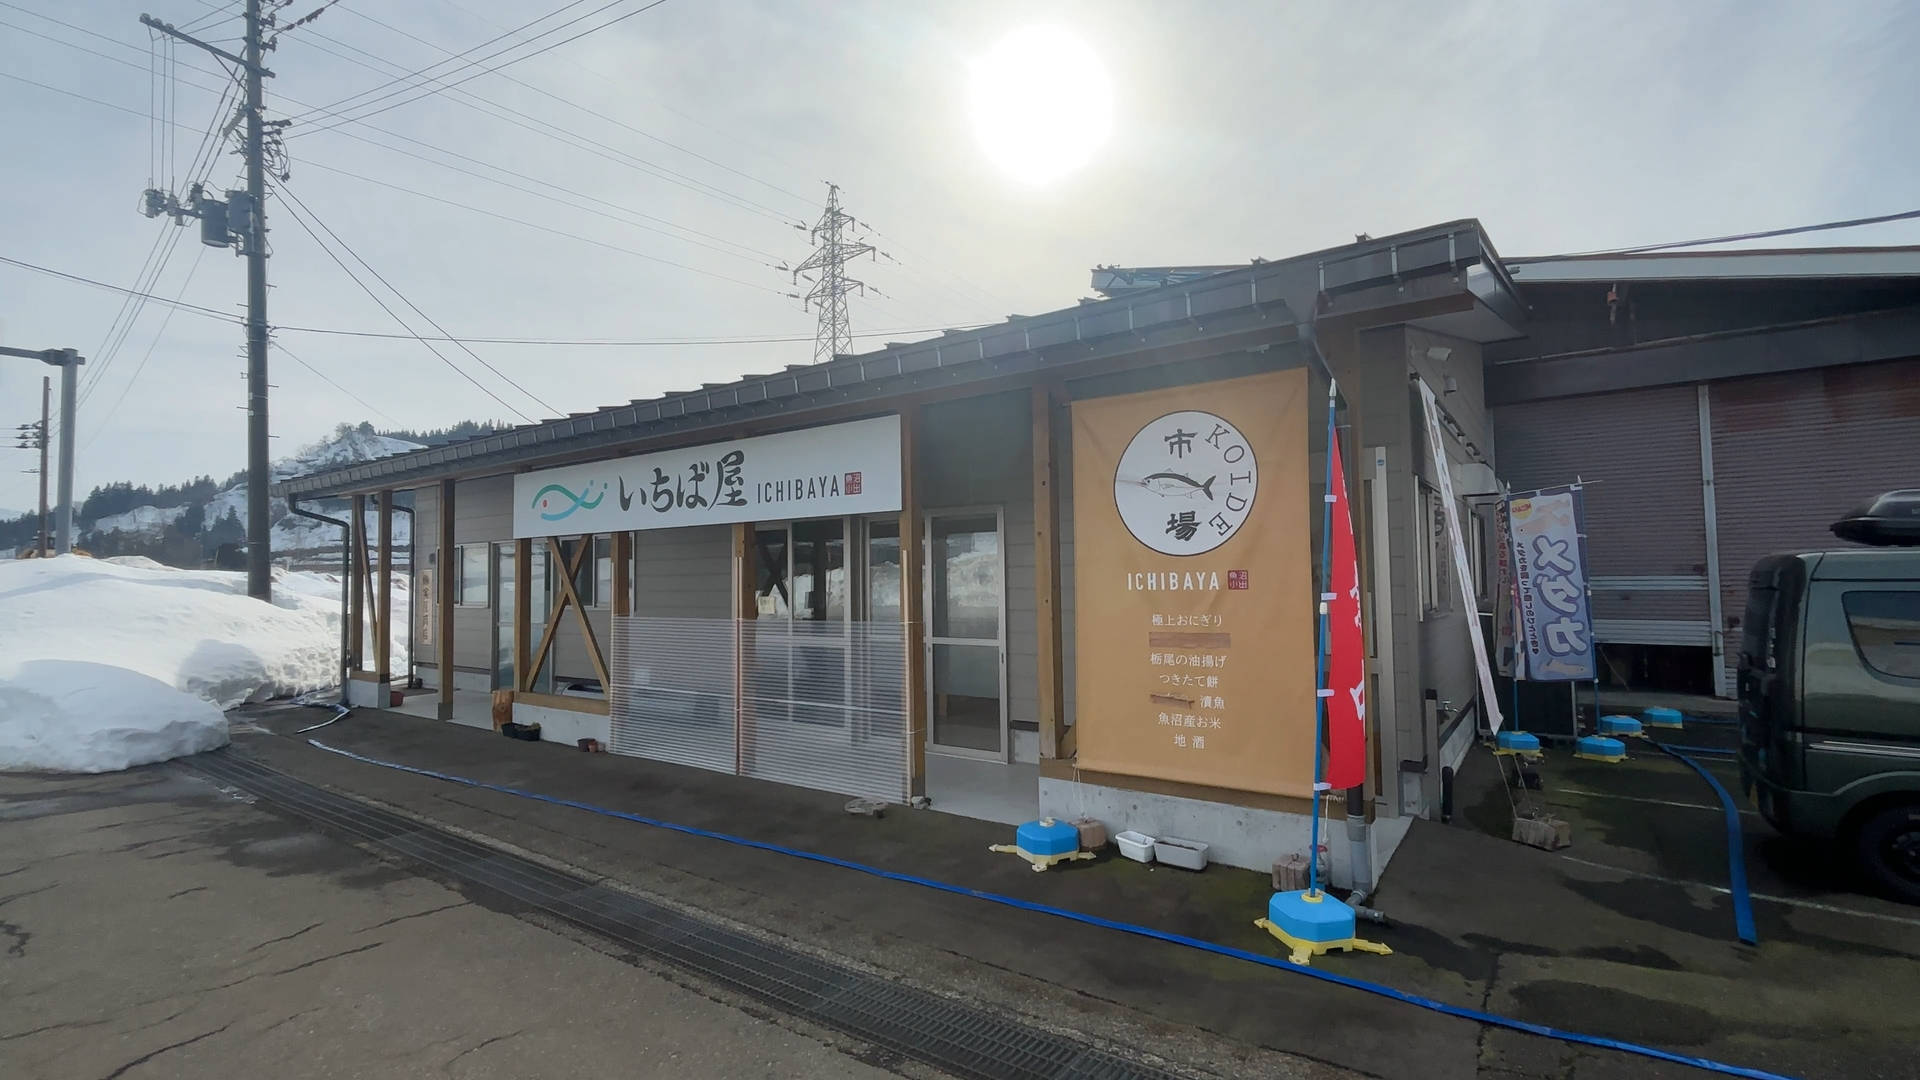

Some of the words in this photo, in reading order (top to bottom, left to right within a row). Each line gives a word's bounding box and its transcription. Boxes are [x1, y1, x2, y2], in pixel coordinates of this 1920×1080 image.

[618, 449, 748, 513] いちば屋
[757, 474, 840, 504] ICHIBAYA
[1204, 423, 1252, 536] KOIDE
[1127, 571, 1220, 591] ICHIBAYA
[1151, 613, 1222, 627] 極上おにぎり
[1150, 652, 1227, 668] 栃尾の油揚げ
[1159, 673, 1219, 688] つきたて餅
[1158, 711, 1222, 729] 魚沼産お米
